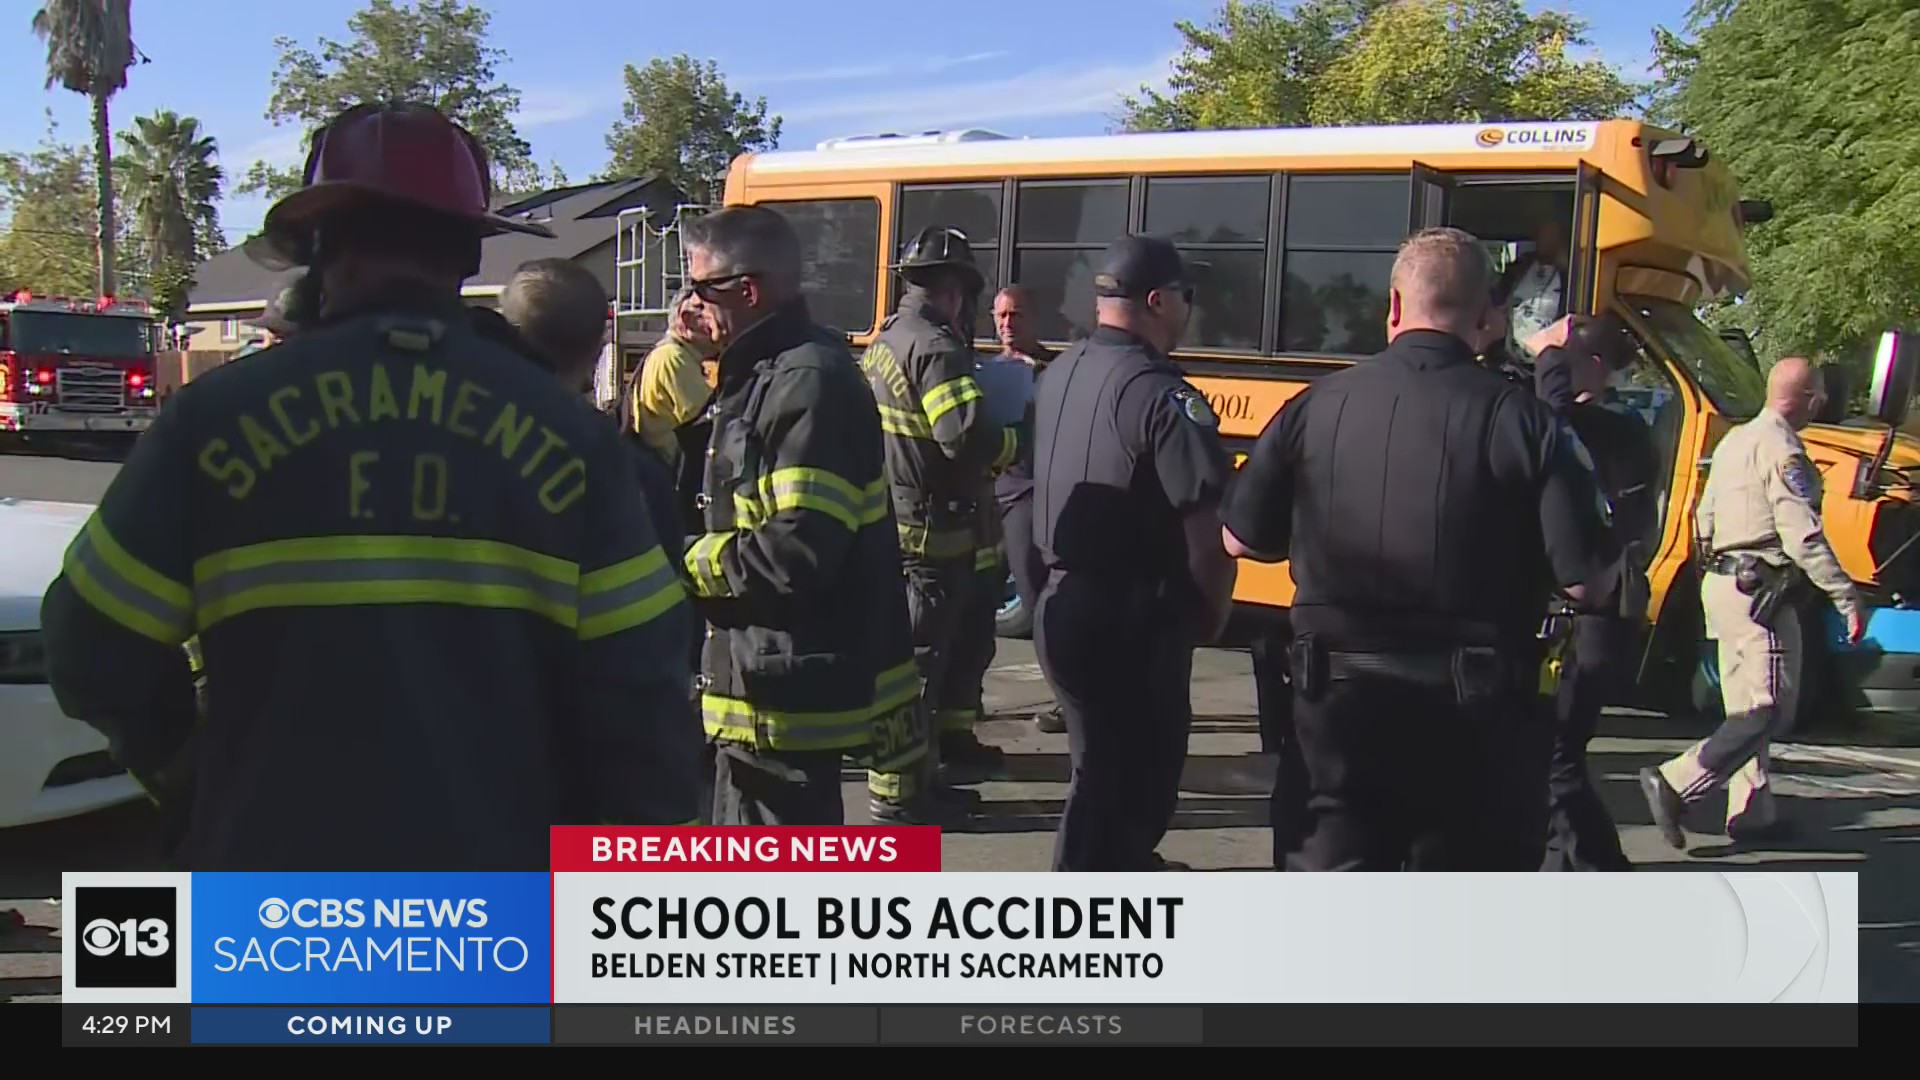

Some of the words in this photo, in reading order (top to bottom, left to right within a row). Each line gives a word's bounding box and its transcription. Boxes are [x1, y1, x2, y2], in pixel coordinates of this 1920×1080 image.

[1507, 129, 1587, 144] COLLINS
[1206, 393, 1255, 420] OOL
[198, 362, 586, 515] SACRAMENTO
